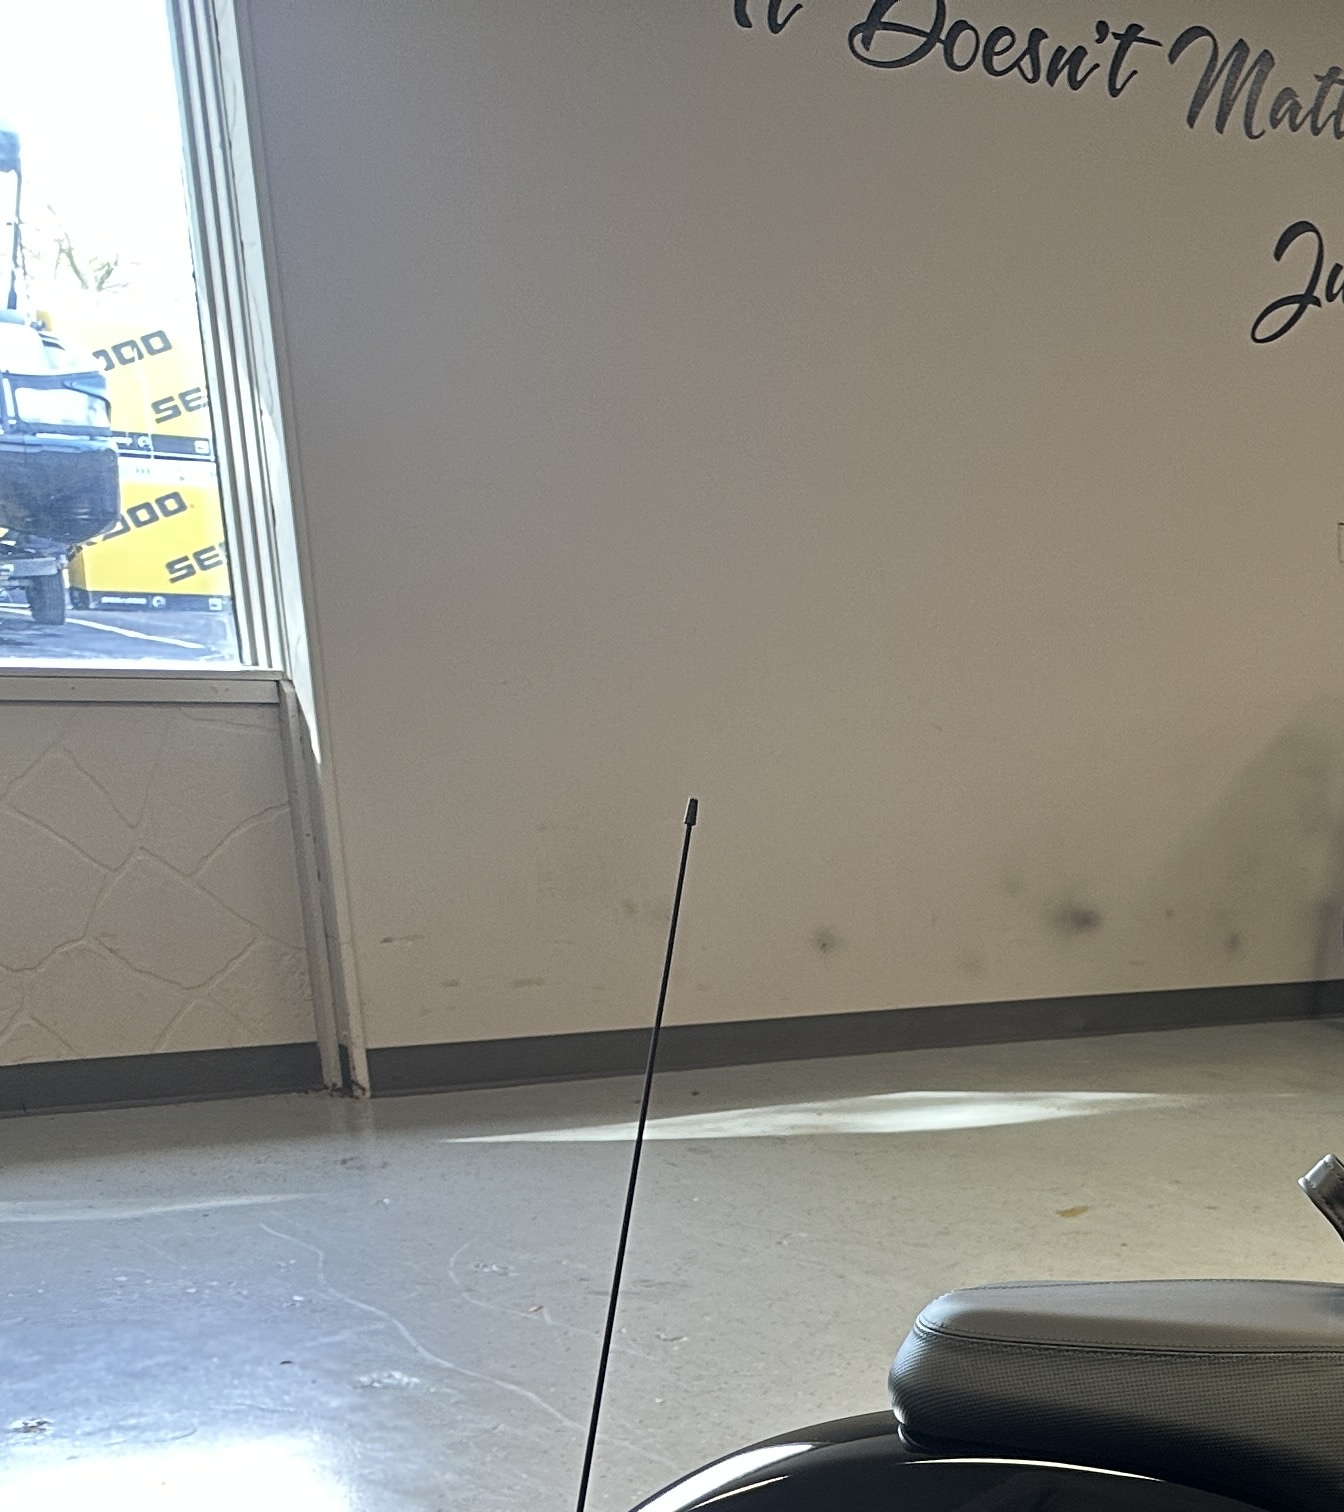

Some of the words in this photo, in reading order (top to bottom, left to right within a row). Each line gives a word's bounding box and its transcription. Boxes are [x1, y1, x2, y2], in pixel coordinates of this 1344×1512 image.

[848, 0, 1163, 97] Doesn't
[151, 387, 208, 424] SE
[165, 542, 227, 584] SE
